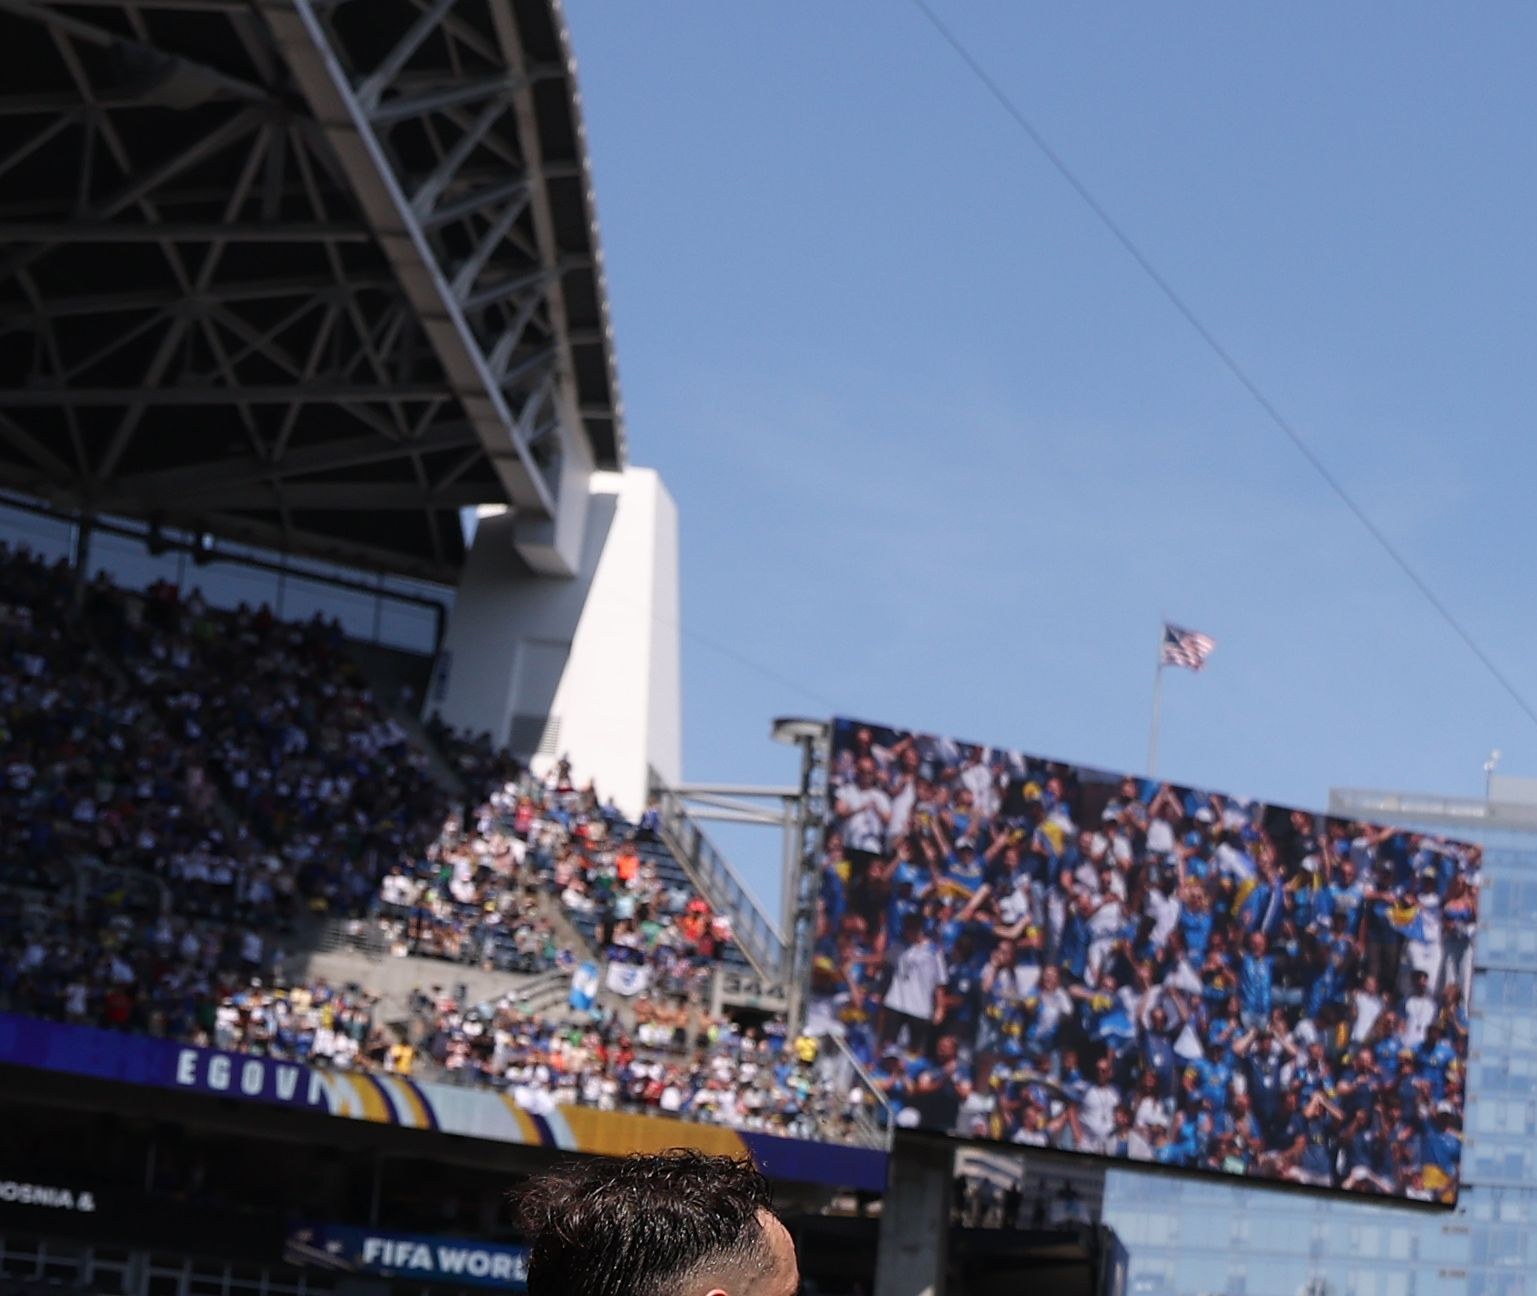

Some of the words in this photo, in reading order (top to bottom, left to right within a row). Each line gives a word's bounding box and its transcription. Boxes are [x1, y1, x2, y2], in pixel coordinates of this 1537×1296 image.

[0, 1181, 74, 1209] OSNIA
[363, 1237, 433, 1270] FIFA
[437, 1247, 528, 1282] WORL
